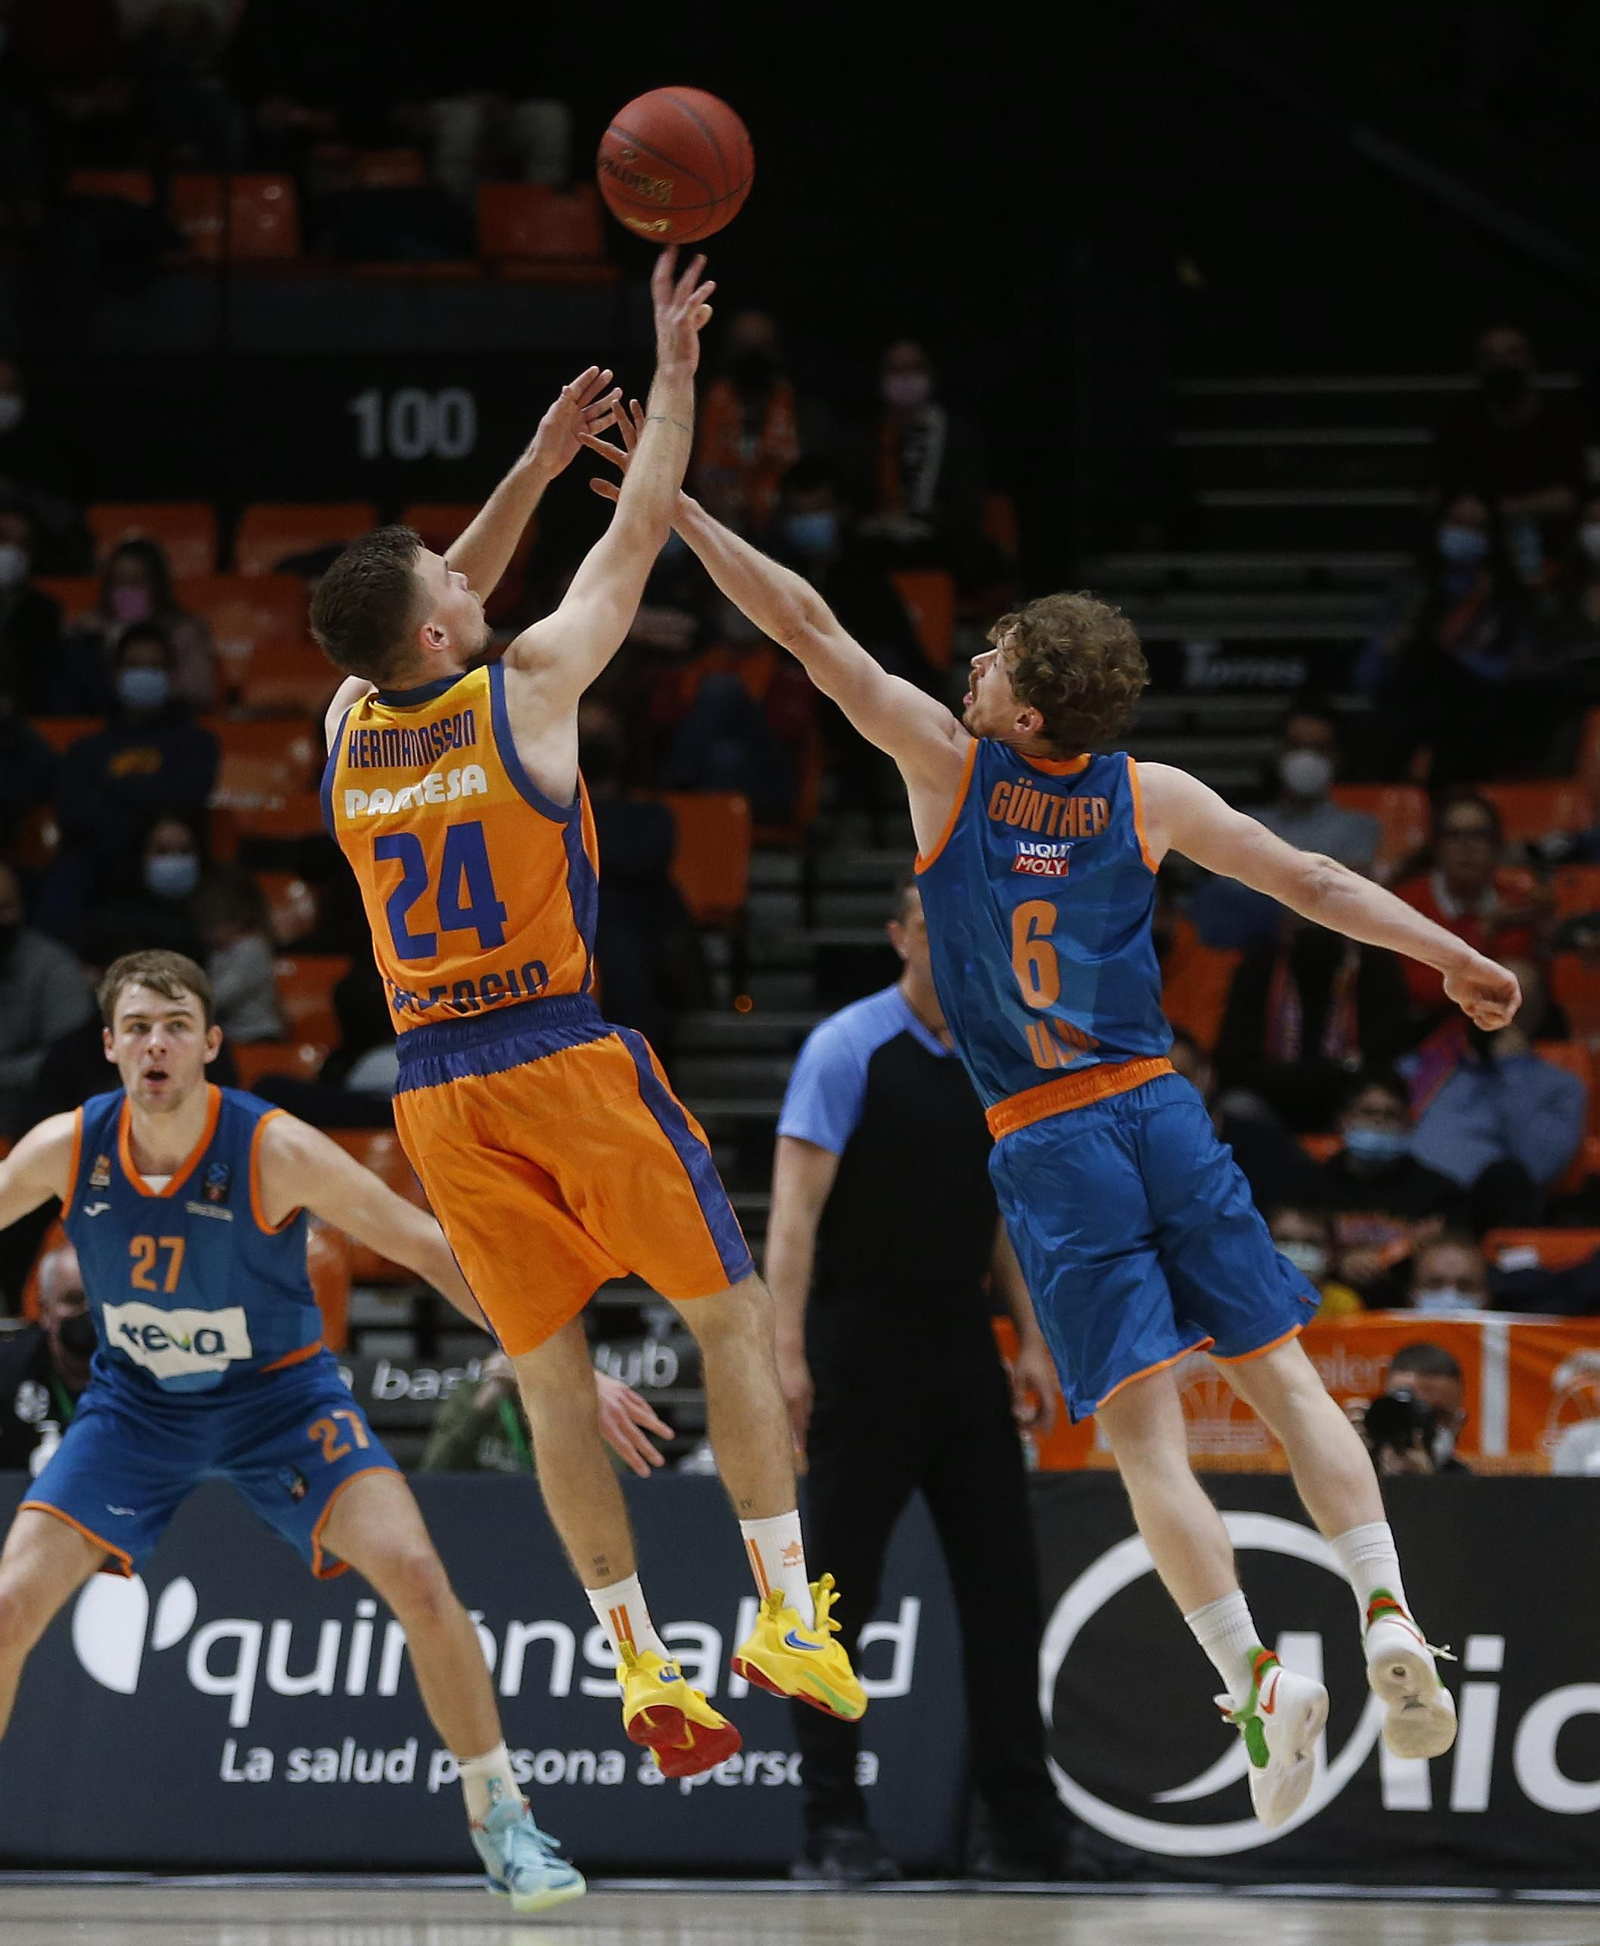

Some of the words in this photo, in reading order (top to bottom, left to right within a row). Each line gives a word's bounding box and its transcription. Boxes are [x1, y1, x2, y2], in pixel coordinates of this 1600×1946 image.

[347, 386, 479, 461] 100
[347, 709, 477, 768] HERMANNSSON
[344, 763, 488, 820] PAMESA
[987, 776, 1111, 838] GÜNTHER
[374, 820, 508, 961] 24
[1015, 856, 1066, 875] MOLY
[1012, 899, 1061, 1009] 6
[129, 1234, 186, 1294] 27
[119, 1322, 226, 1356] teva
[308, 1409, 370, 1464] 27
[219, 1738, 275, 1784] La
[285, 1737, 418, 1784] salud
[426, 1747, 627, 1794] psona
